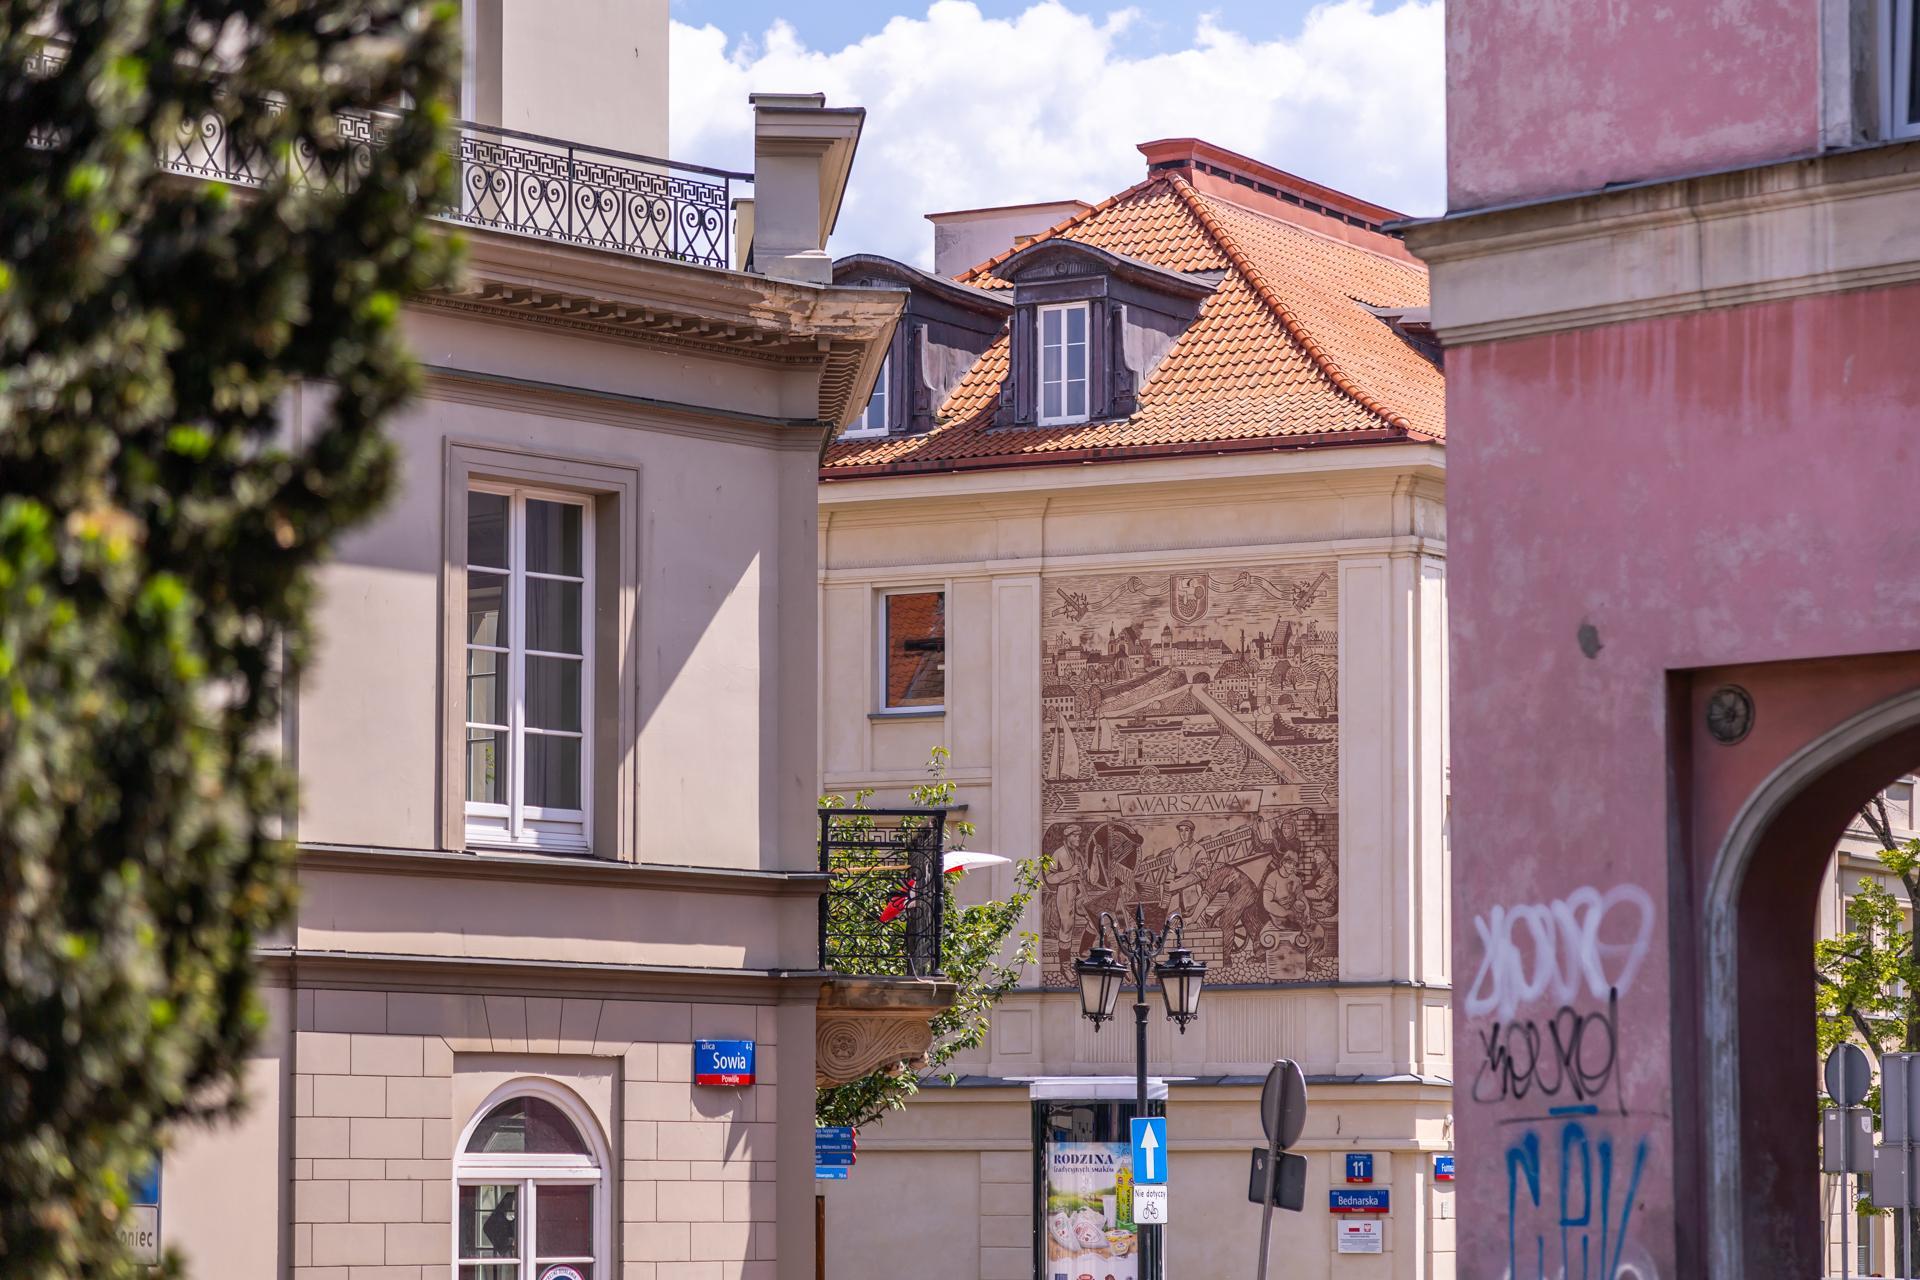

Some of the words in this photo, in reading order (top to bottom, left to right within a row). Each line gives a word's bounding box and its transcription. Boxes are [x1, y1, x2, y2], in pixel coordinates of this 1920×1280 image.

[1136, 794, 1244, 812] WARSZAWA
[701, 1042, 716, 1050] ulica
[712, 1051, 746, 1070] Sowia
[1054, 1154, 1113, 1164] RODZINA
[1352, 1160, 1364, 1177] 11
[1135, 1188, 1144, 1198] Nie
[1146, 1189, 1166, 1200] dotyczy
[1338, 1195, 1379, 1206] Bednarska
[120, 1226, 152, 1247] oniec
